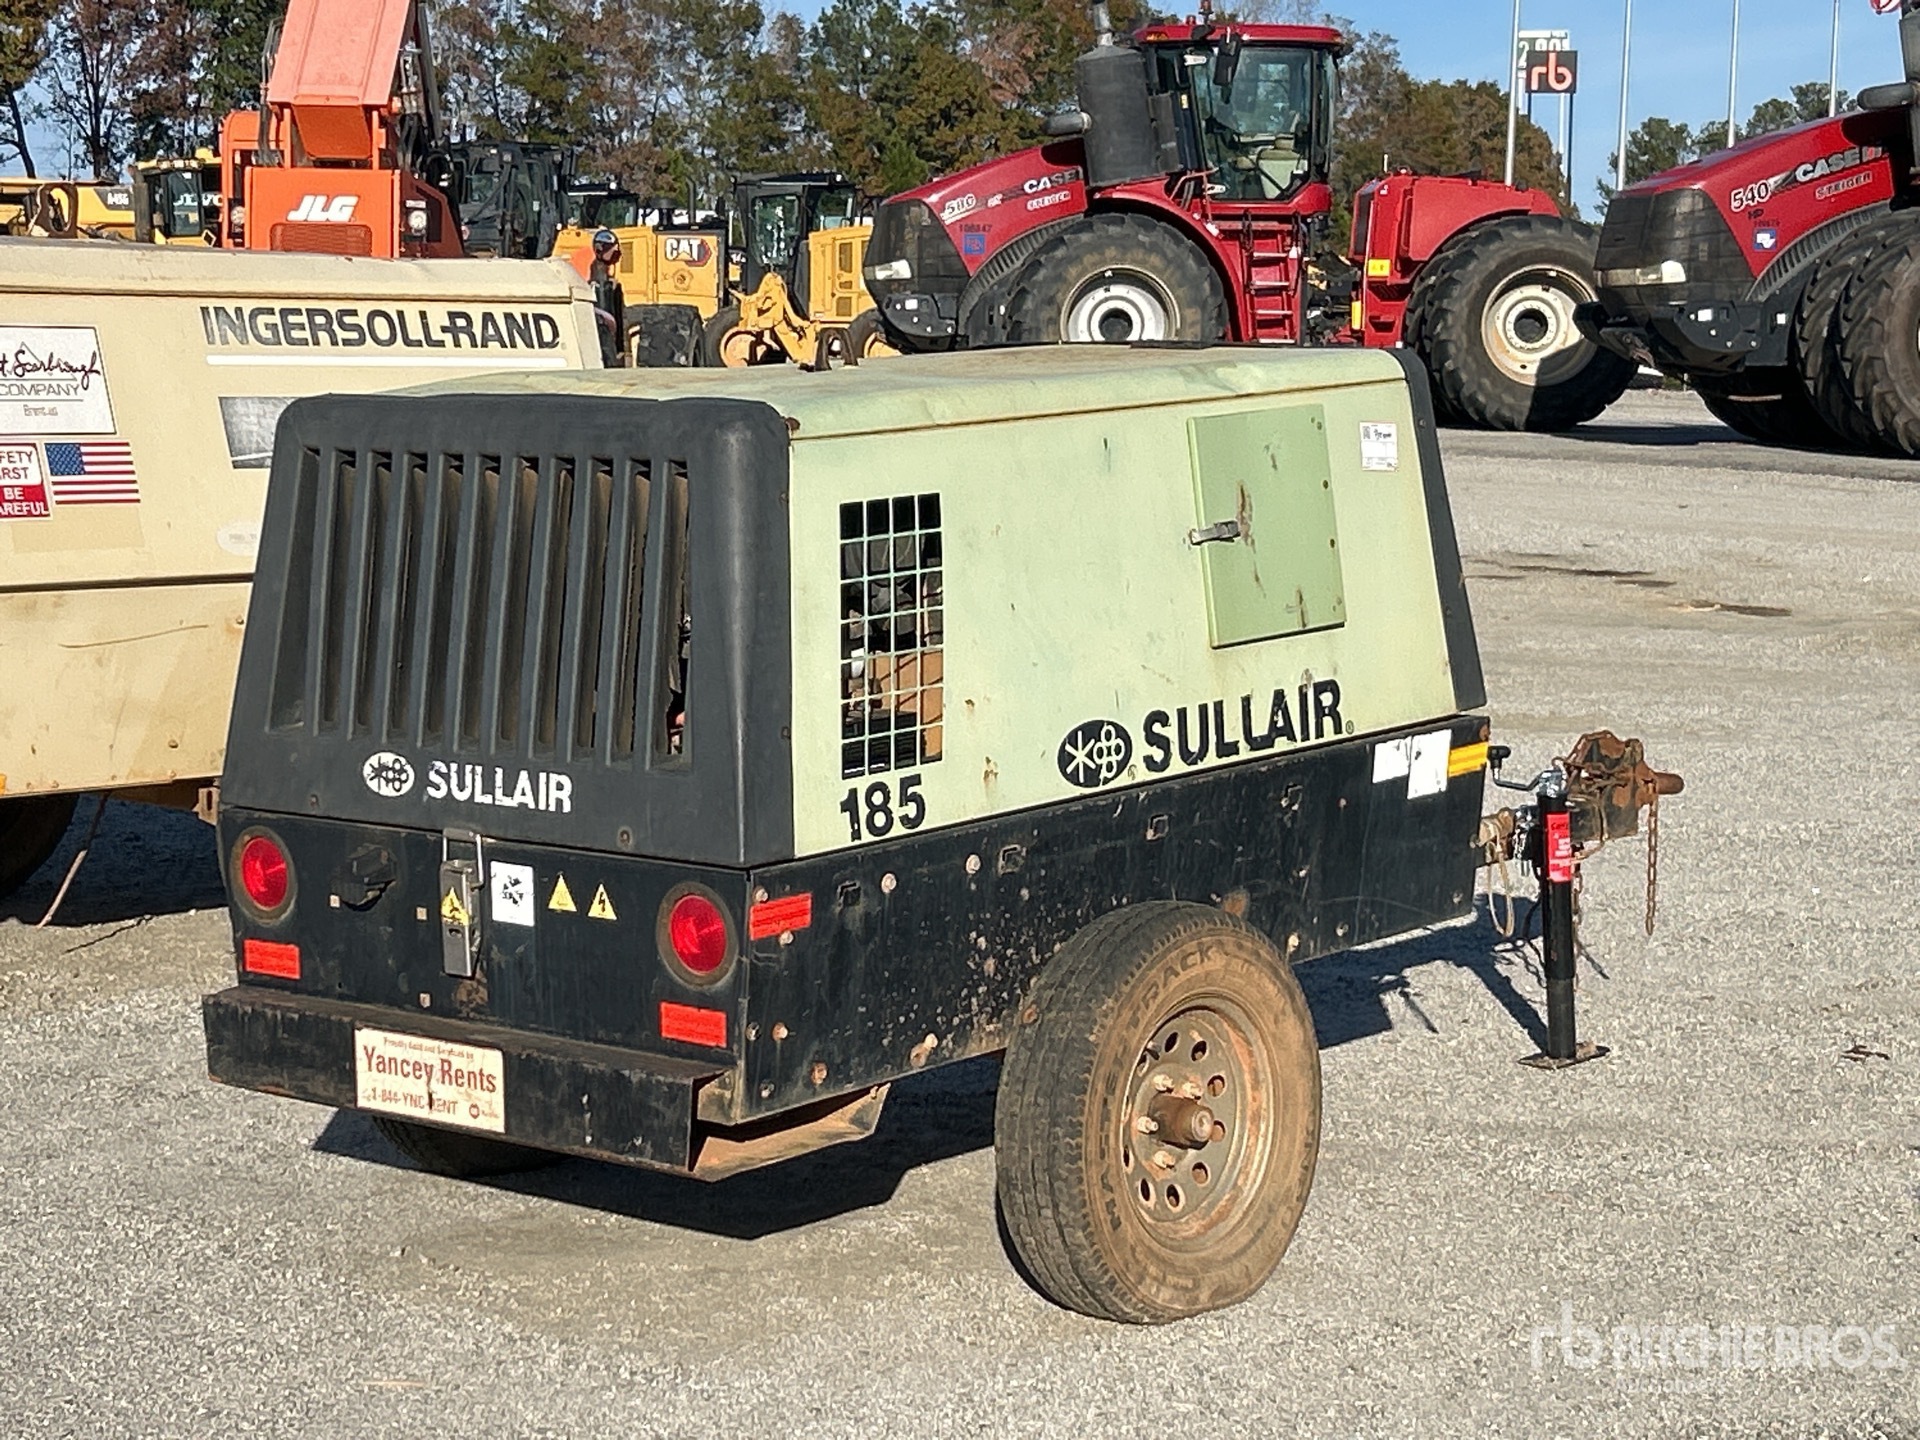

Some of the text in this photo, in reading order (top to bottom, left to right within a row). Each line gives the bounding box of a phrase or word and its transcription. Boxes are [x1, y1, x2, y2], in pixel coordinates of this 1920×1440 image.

[1531, 52, 1572, 91] rb
[1024, 169, 1078, 194] CASE
[1795, 147, 1860, 183] CASE
[1731, 180, 1771, 212] 540
[1815, 171, 1873, 200] STEIGER
[287, 195, 358, 222] JLG
[665, 238, 702, 261] CAT
[200, 306, 560, 350] INGERSOLL-RAND
[0, 466, 29, 480] RST
[3, 487, 25, 500] BE
[1142, 679, 1343, 772] SULLAIR
[426, 760, 573, 813] SULLAIR
[840, 773, 926, 842] 185
[363, 1045, 497, 1094] Yancey Rents
